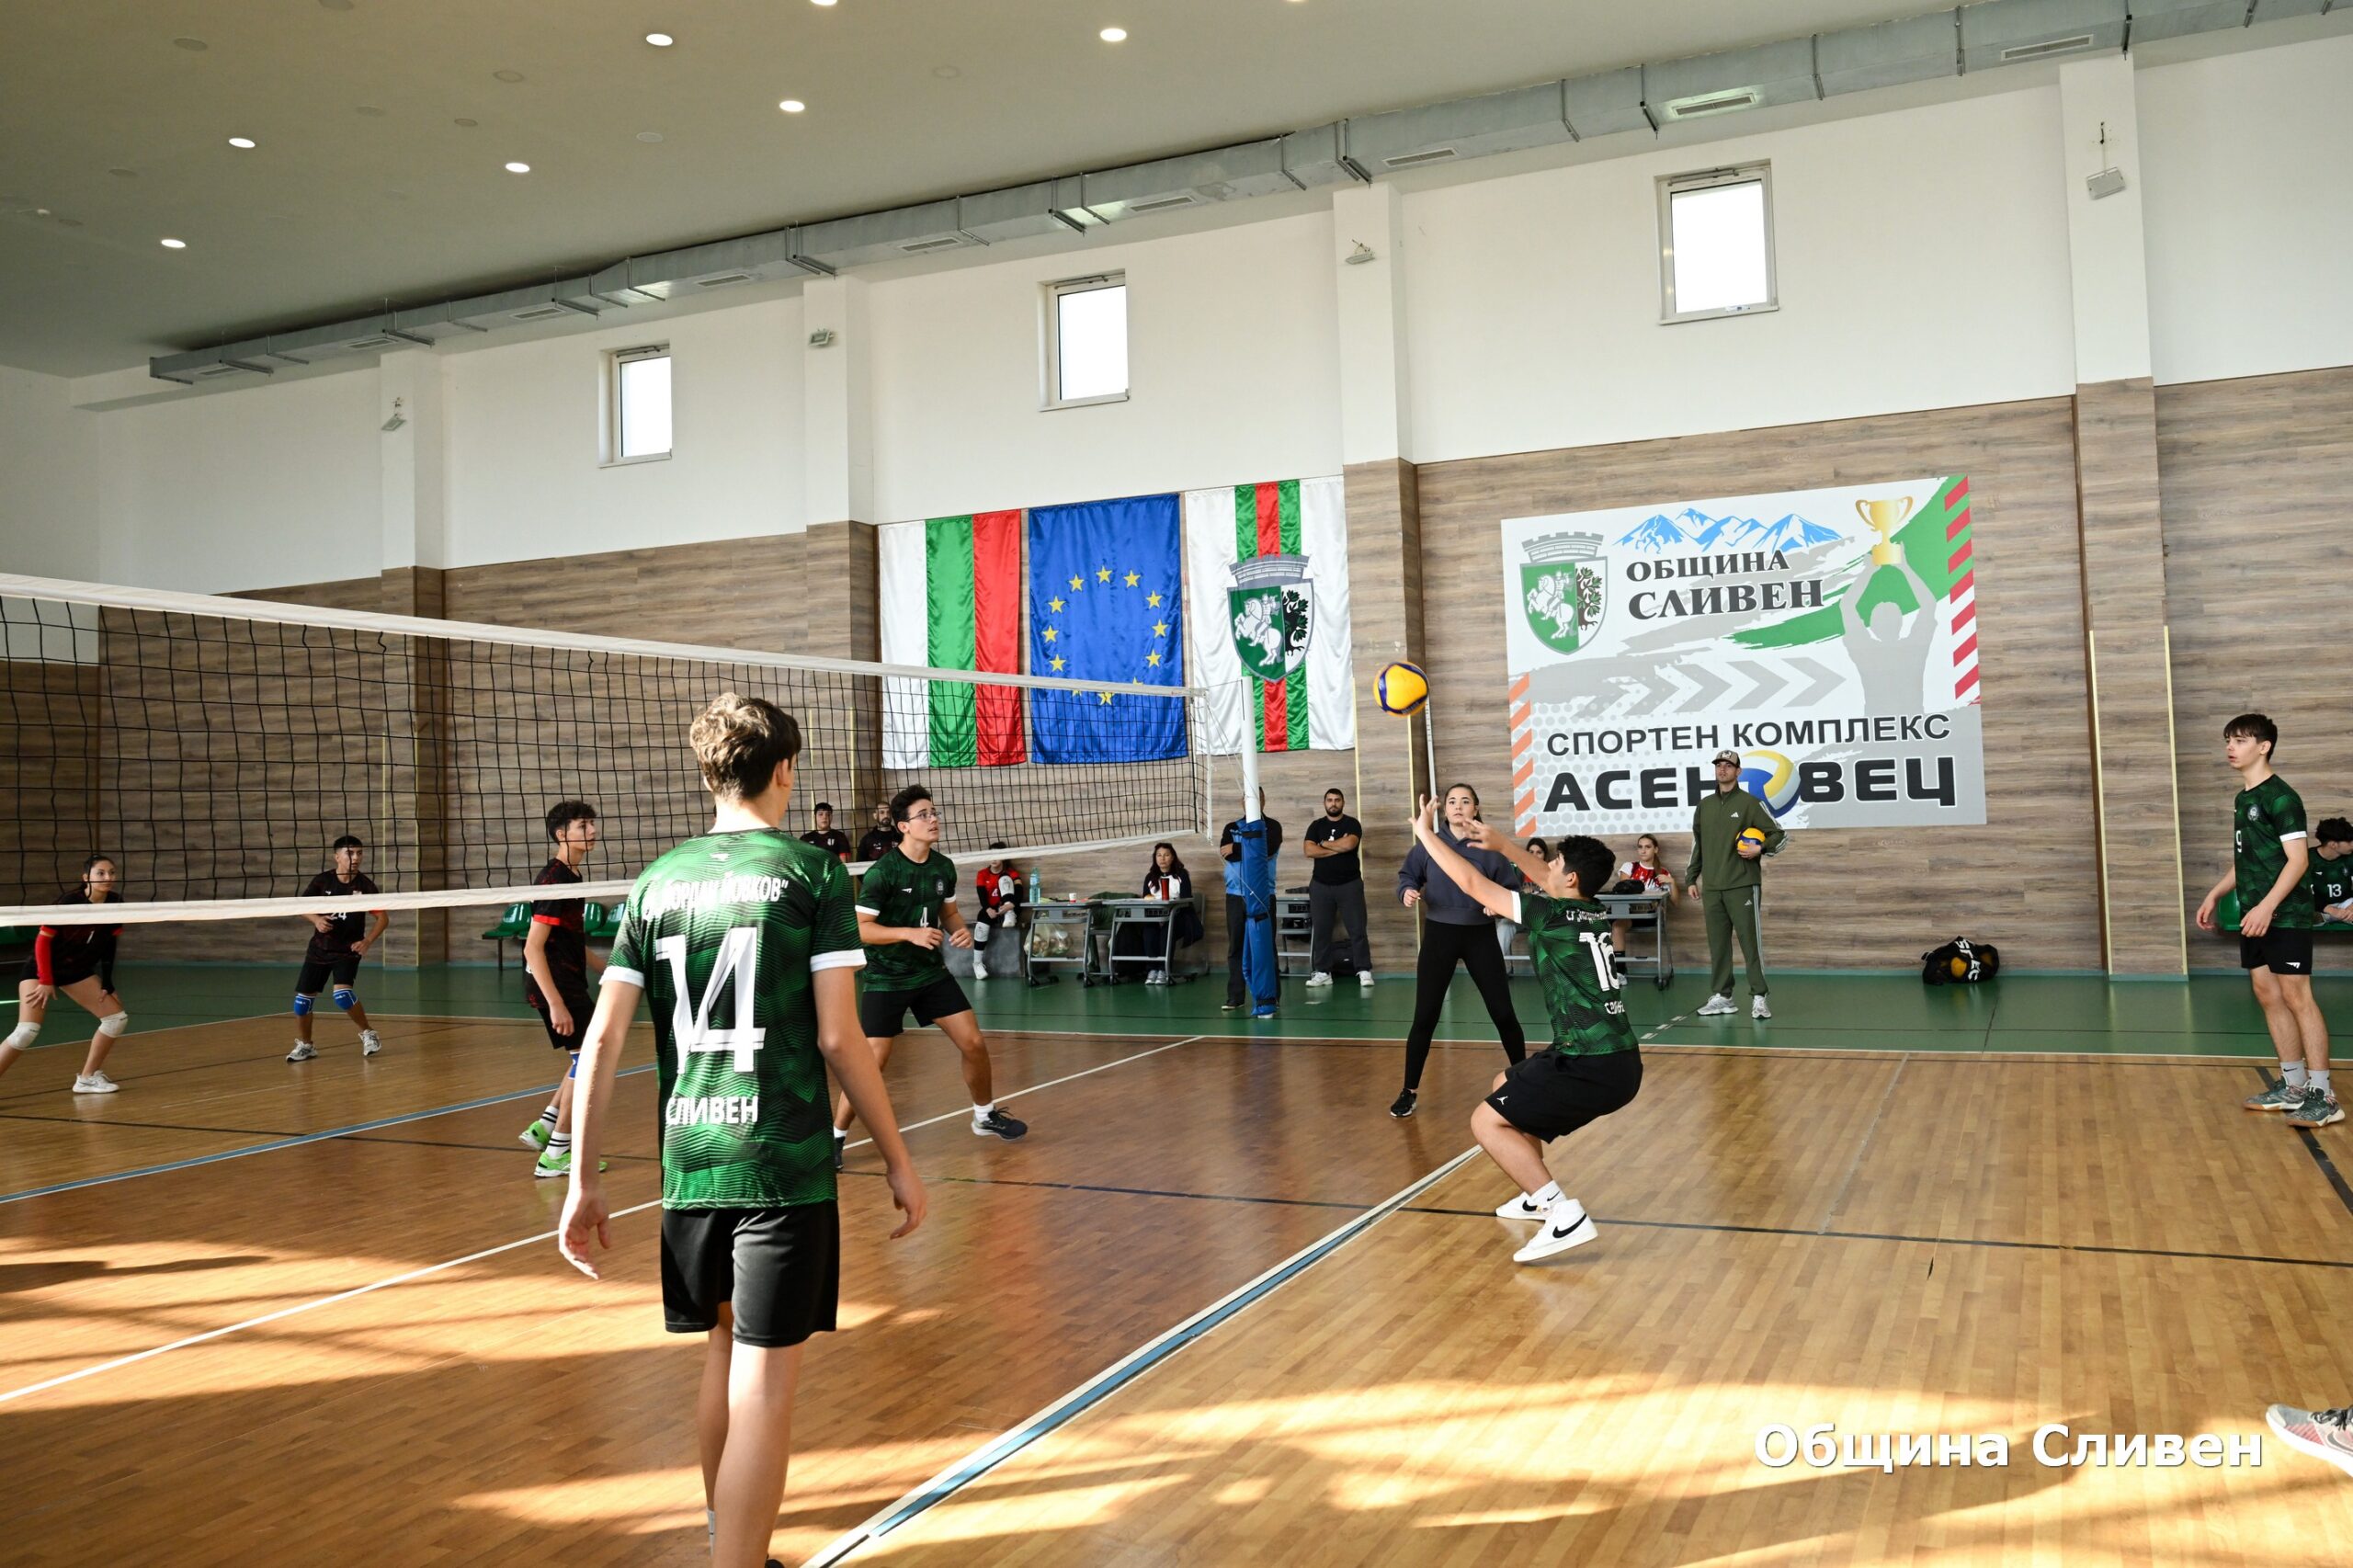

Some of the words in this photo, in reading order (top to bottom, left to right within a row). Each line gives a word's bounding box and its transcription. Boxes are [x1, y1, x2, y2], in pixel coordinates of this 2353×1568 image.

[1626, 550, 1790, 582] ОБЩИНА
[1628, 579, 1824, 620] СЛИВЕН
[1548, 725, 1719, 756] СПОРТЕН
[1733, 714, 1950, 747] КОМПЛЕКС
[2327, 883, 2342, 898] 13
[920, 906, 929, 928] 4
[655, 926, 767, 1074] 14
[665, 1096, 758, 1126] СЛИВЕН
